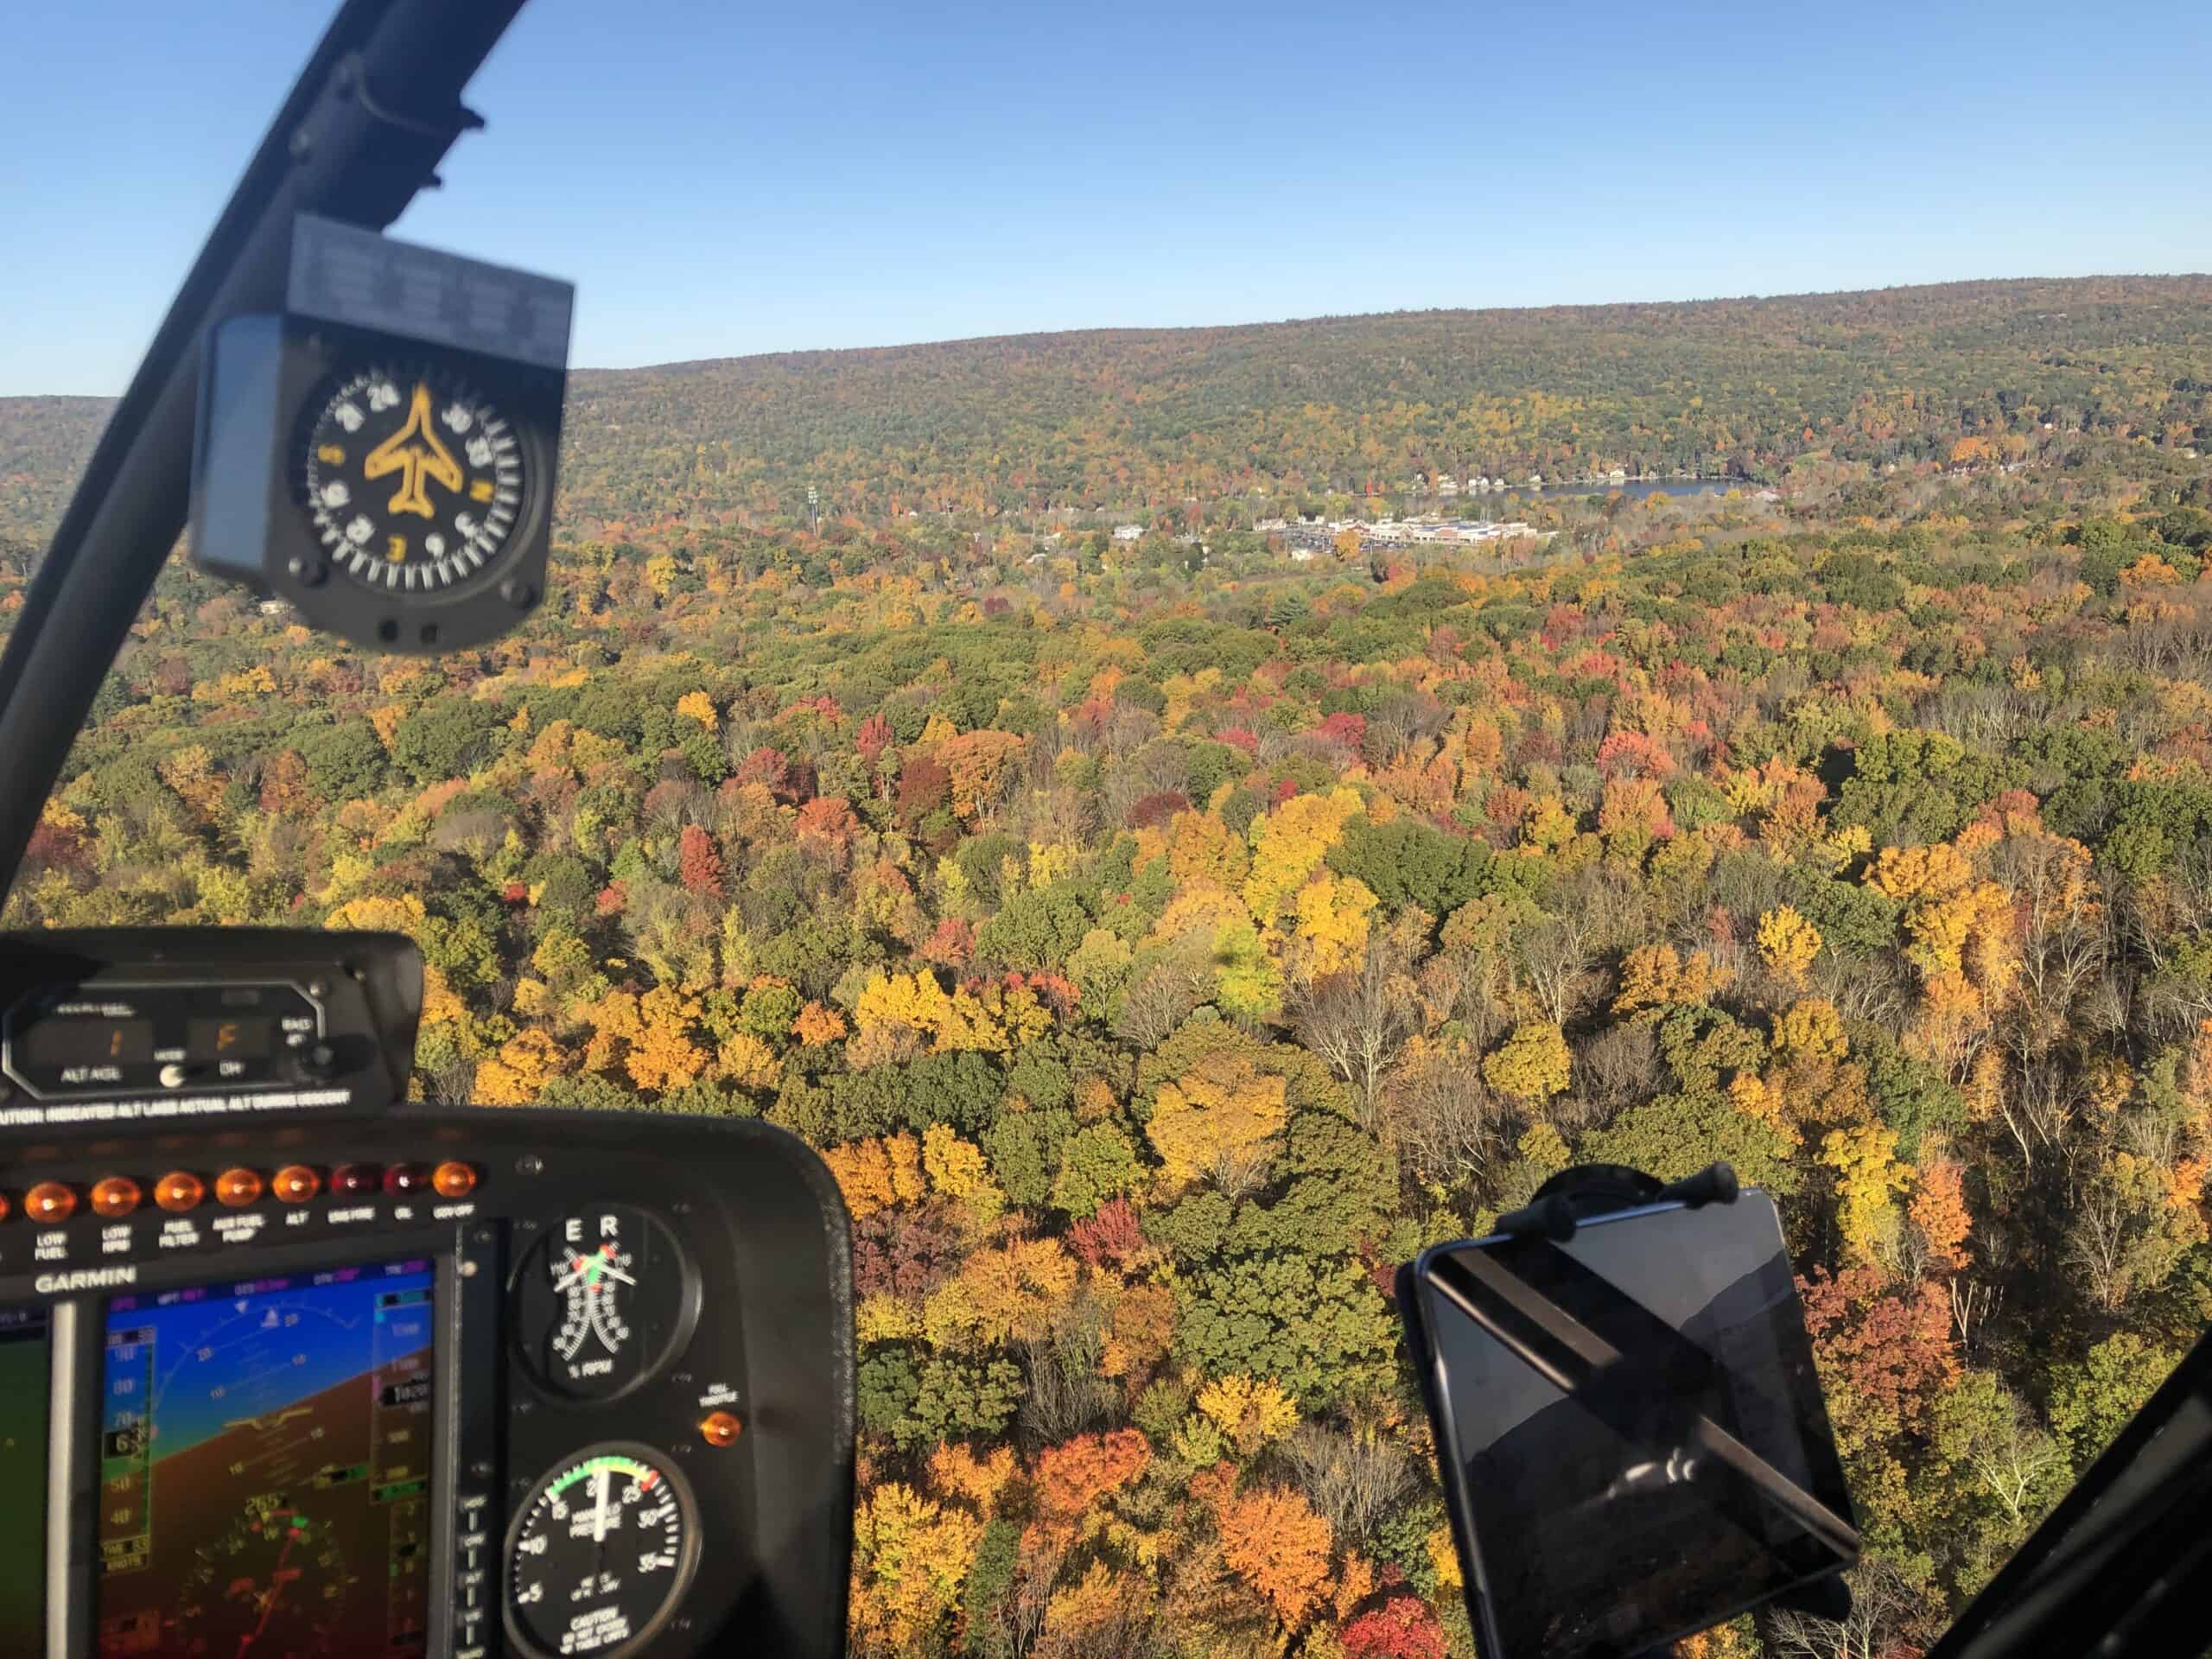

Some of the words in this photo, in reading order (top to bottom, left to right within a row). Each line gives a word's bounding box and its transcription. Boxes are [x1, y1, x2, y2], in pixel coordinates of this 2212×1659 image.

[565, 1217, 583, 1243] E
[600, 1213, 619, 1238] R
[36, 1231, 67, 1248] LOW
[35, 1265, 137, 1294] GARMIN
[622, 1484, 643, 1505] 25
[638, 1508, 658, 1529] 30
[638, 1552, 658, 1573] 35
[530, 1580, 543, 1603] 5
[570, 1605, 619, 1632] CAUTION
